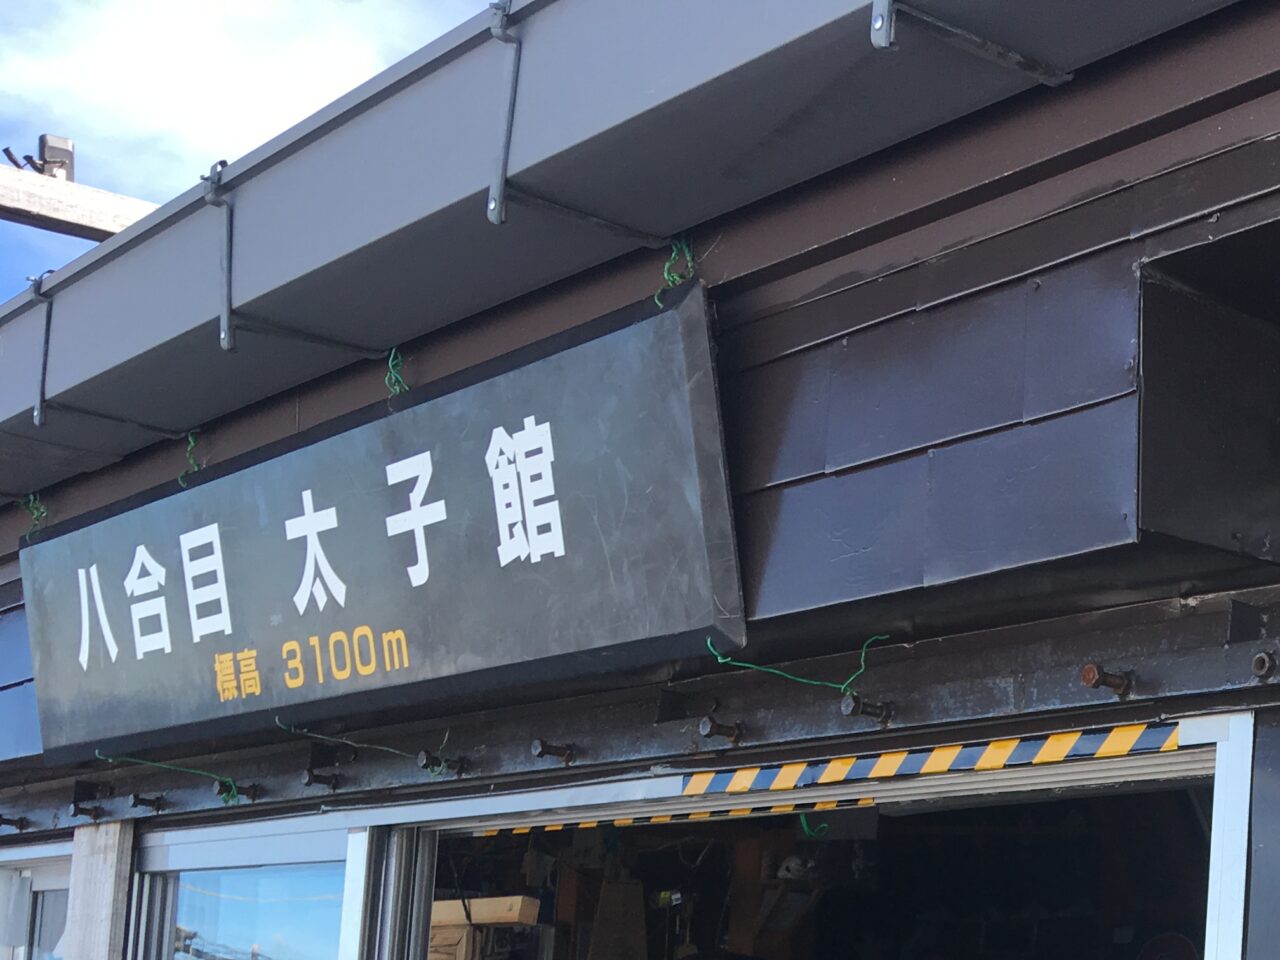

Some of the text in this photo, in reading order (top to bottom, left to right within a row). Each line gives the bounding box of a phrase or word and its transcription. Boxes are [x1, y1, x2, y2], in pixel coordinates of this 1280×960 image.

[78, 522, 233, 672] 八合目
[213, 625, 410, 702] 標高 3100m
